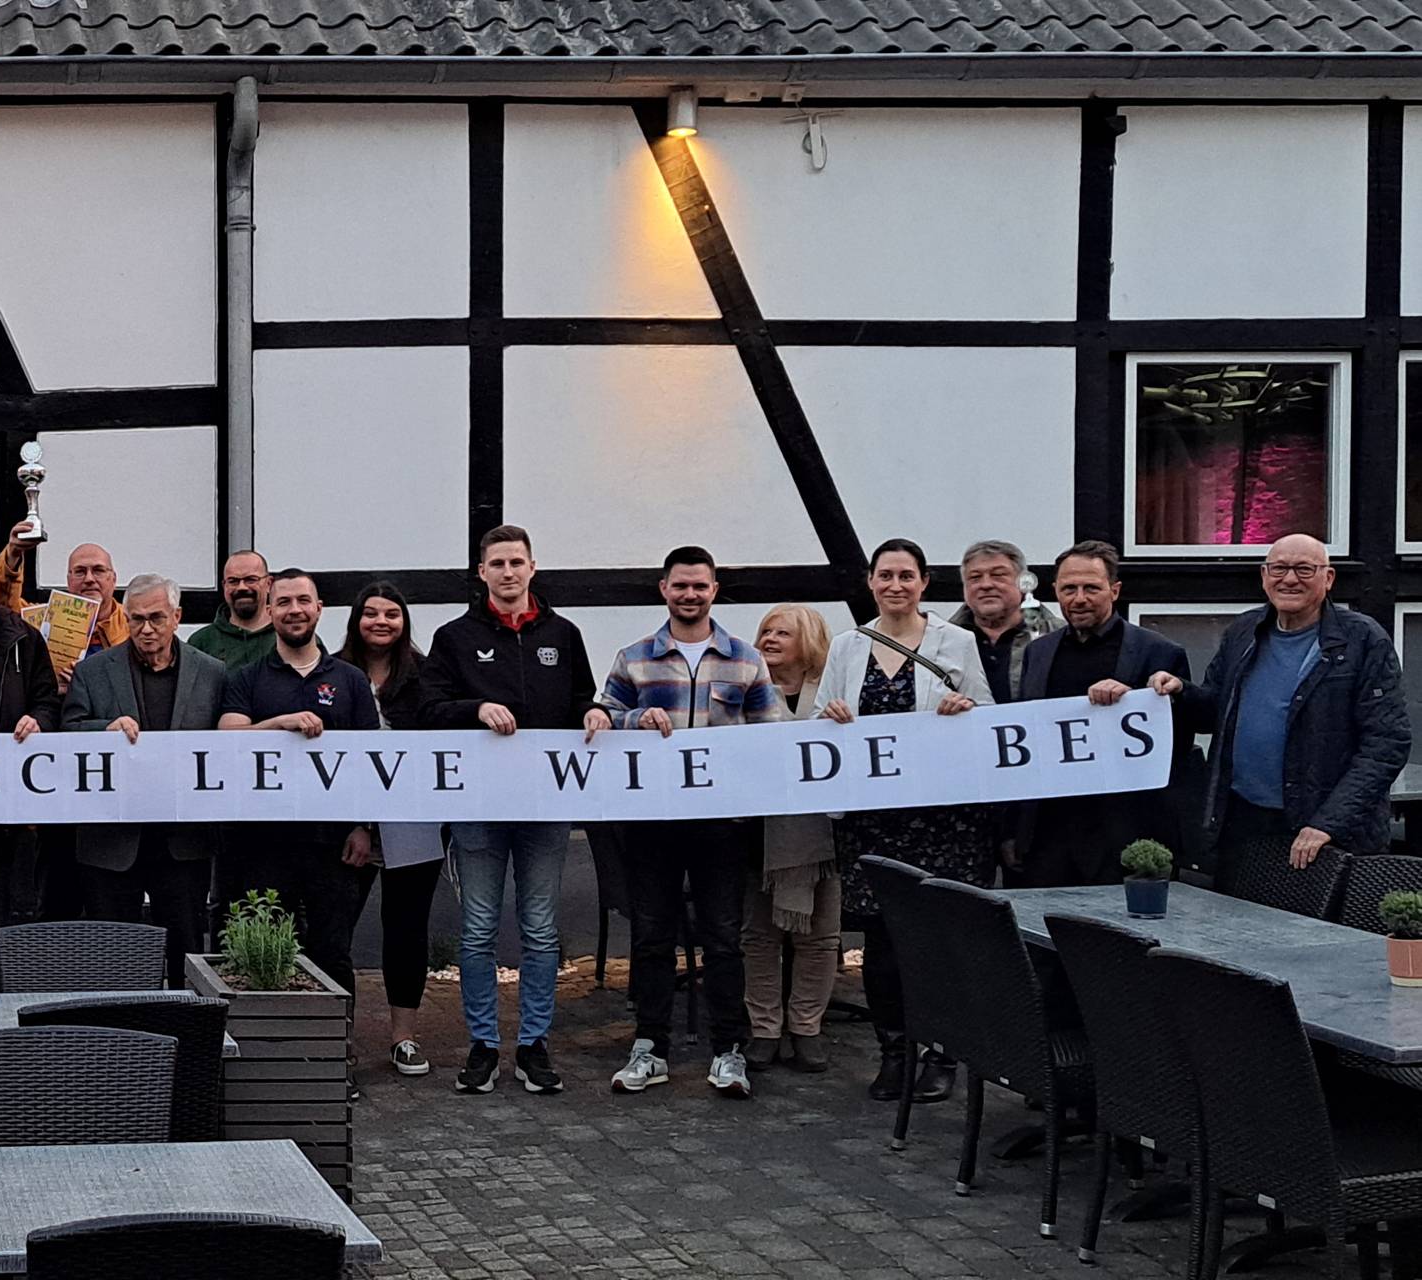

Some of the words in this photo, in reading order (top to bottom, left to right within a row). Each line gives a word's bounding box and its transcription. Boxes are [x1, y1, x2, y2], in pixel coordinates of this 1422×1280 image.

[193, 750, 464, 791] LEVVE
[544, 746, 713, 791] WIE
[795, 735, 901, 783] DE
[991, 711, 1156, 769] BES
